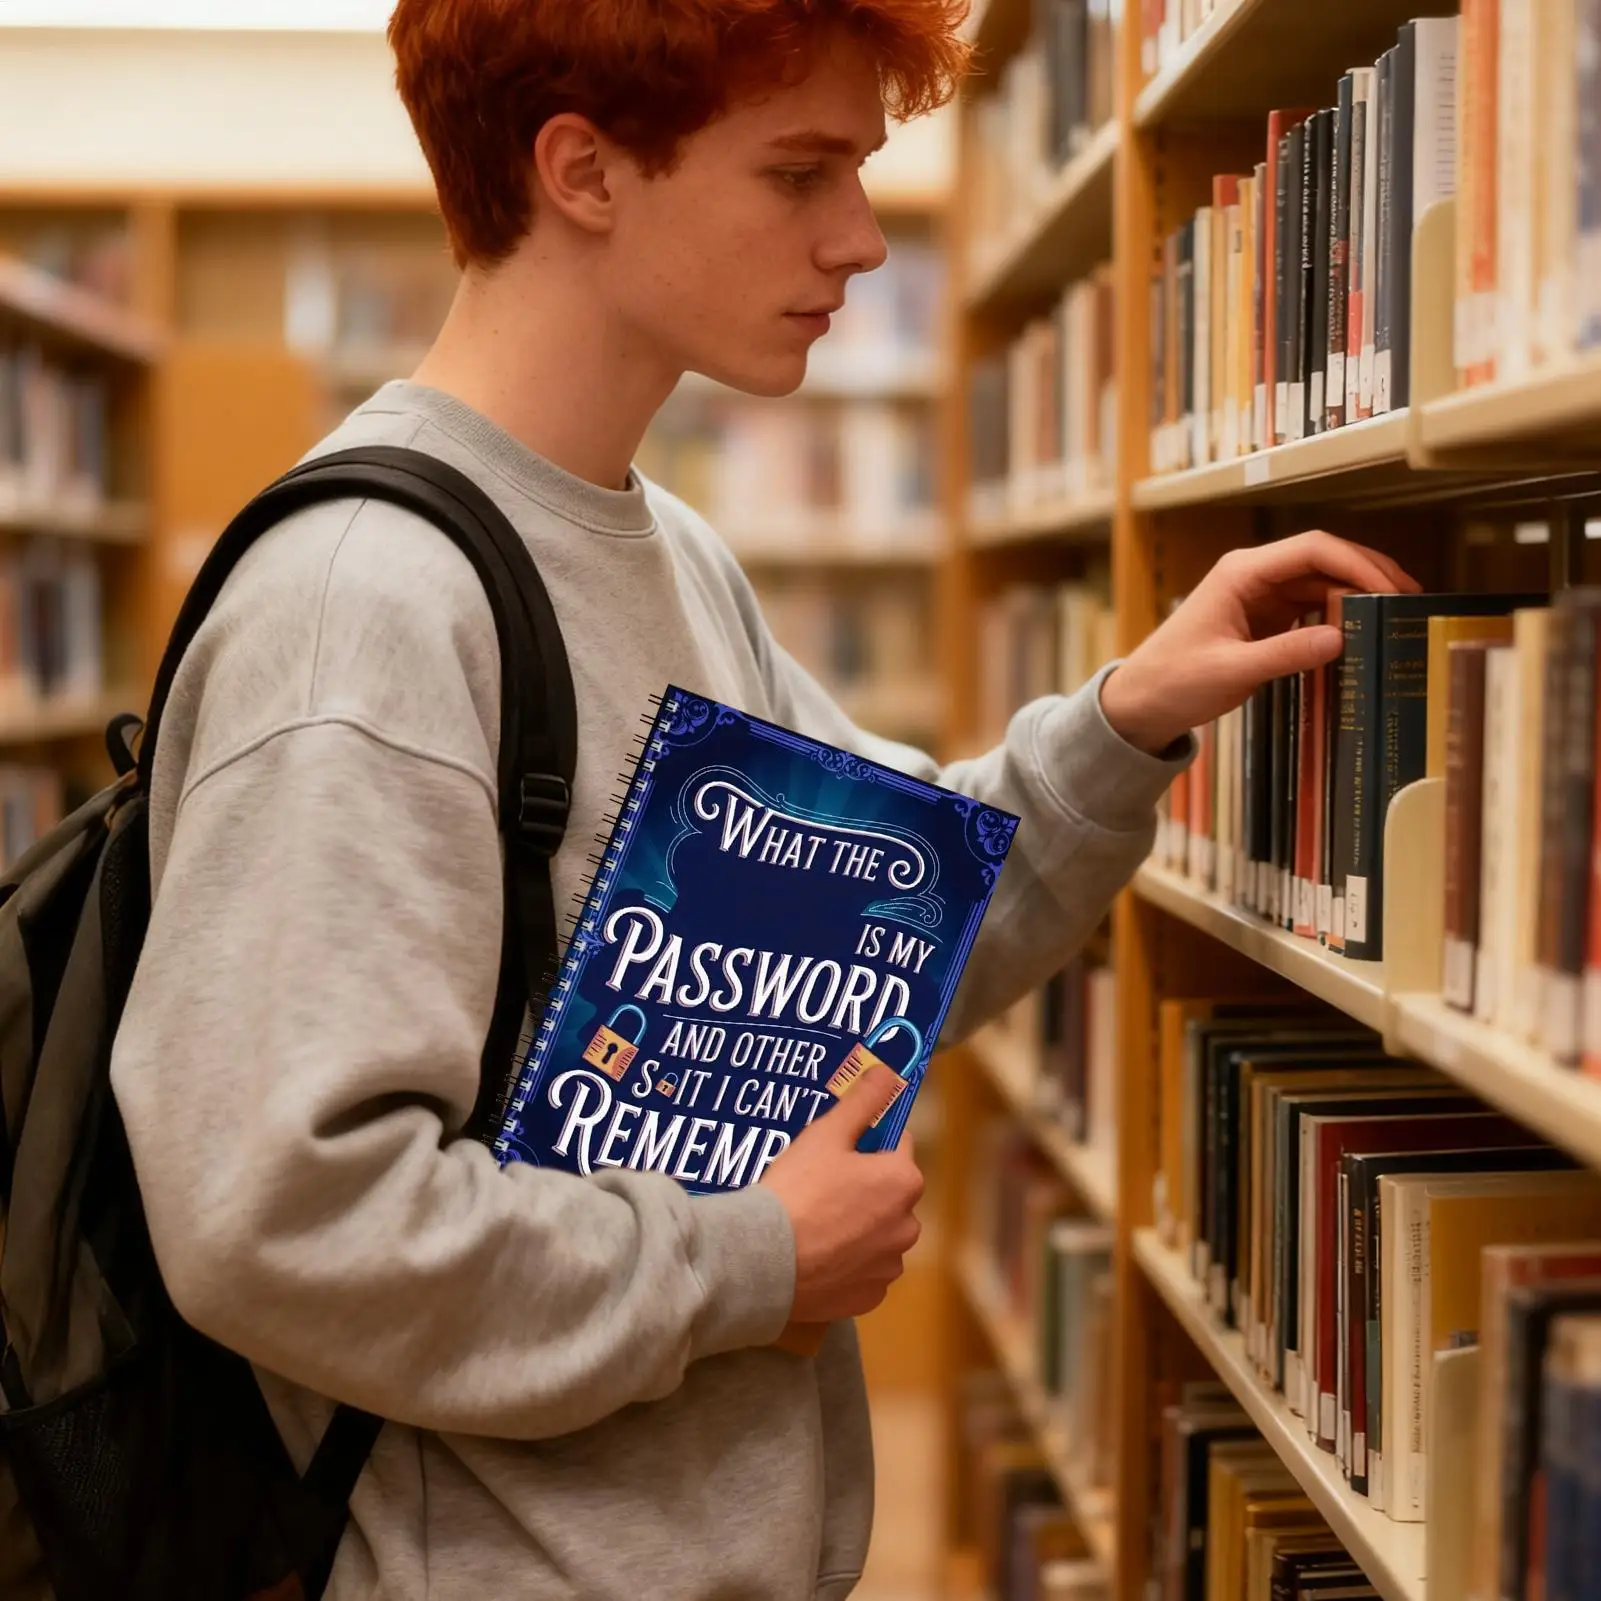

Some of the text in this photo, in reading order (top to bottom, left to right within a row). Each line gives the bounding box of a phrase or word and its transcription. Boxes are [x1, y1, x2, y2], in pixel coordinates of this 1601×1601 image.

[719, 794, 884, 882] WHAT THE
[603, 906, 910, 1043] PASSWORD
[855, 923, 936, 974] IS MY
[659, 1021, 827, 1081] AND OTHER
[632, 1060, 829, 1127] SIT I CAN'T
